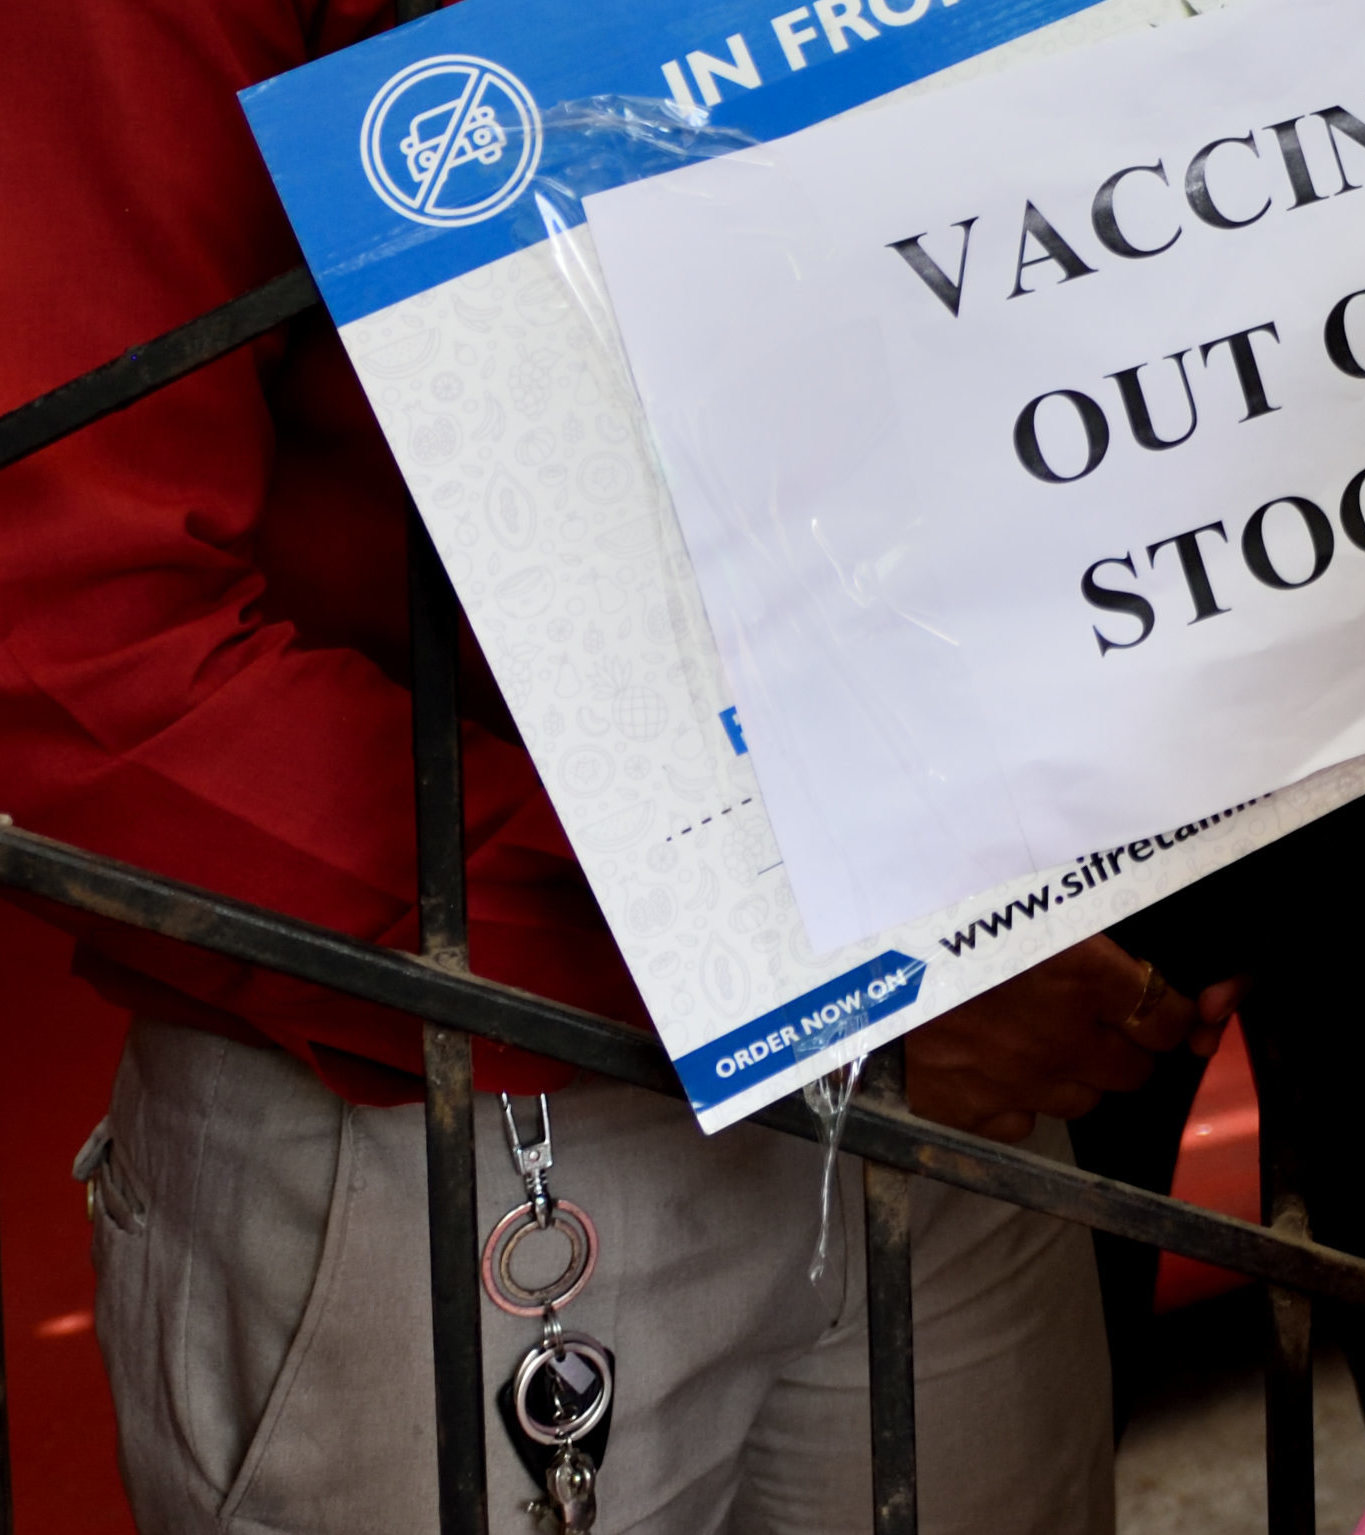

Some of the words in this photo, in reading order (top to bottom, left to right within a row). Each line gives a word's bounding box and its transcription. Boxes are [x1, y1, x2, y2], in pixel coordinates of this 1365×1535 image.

[661, 33, 763, 120] IN
[1013, 321, 1282, 484] OUT
[715, 1025, 800, 1079] ORDER
[801, 990, 861, 1035] NOW
[867, 969, 908, 1001] ON
